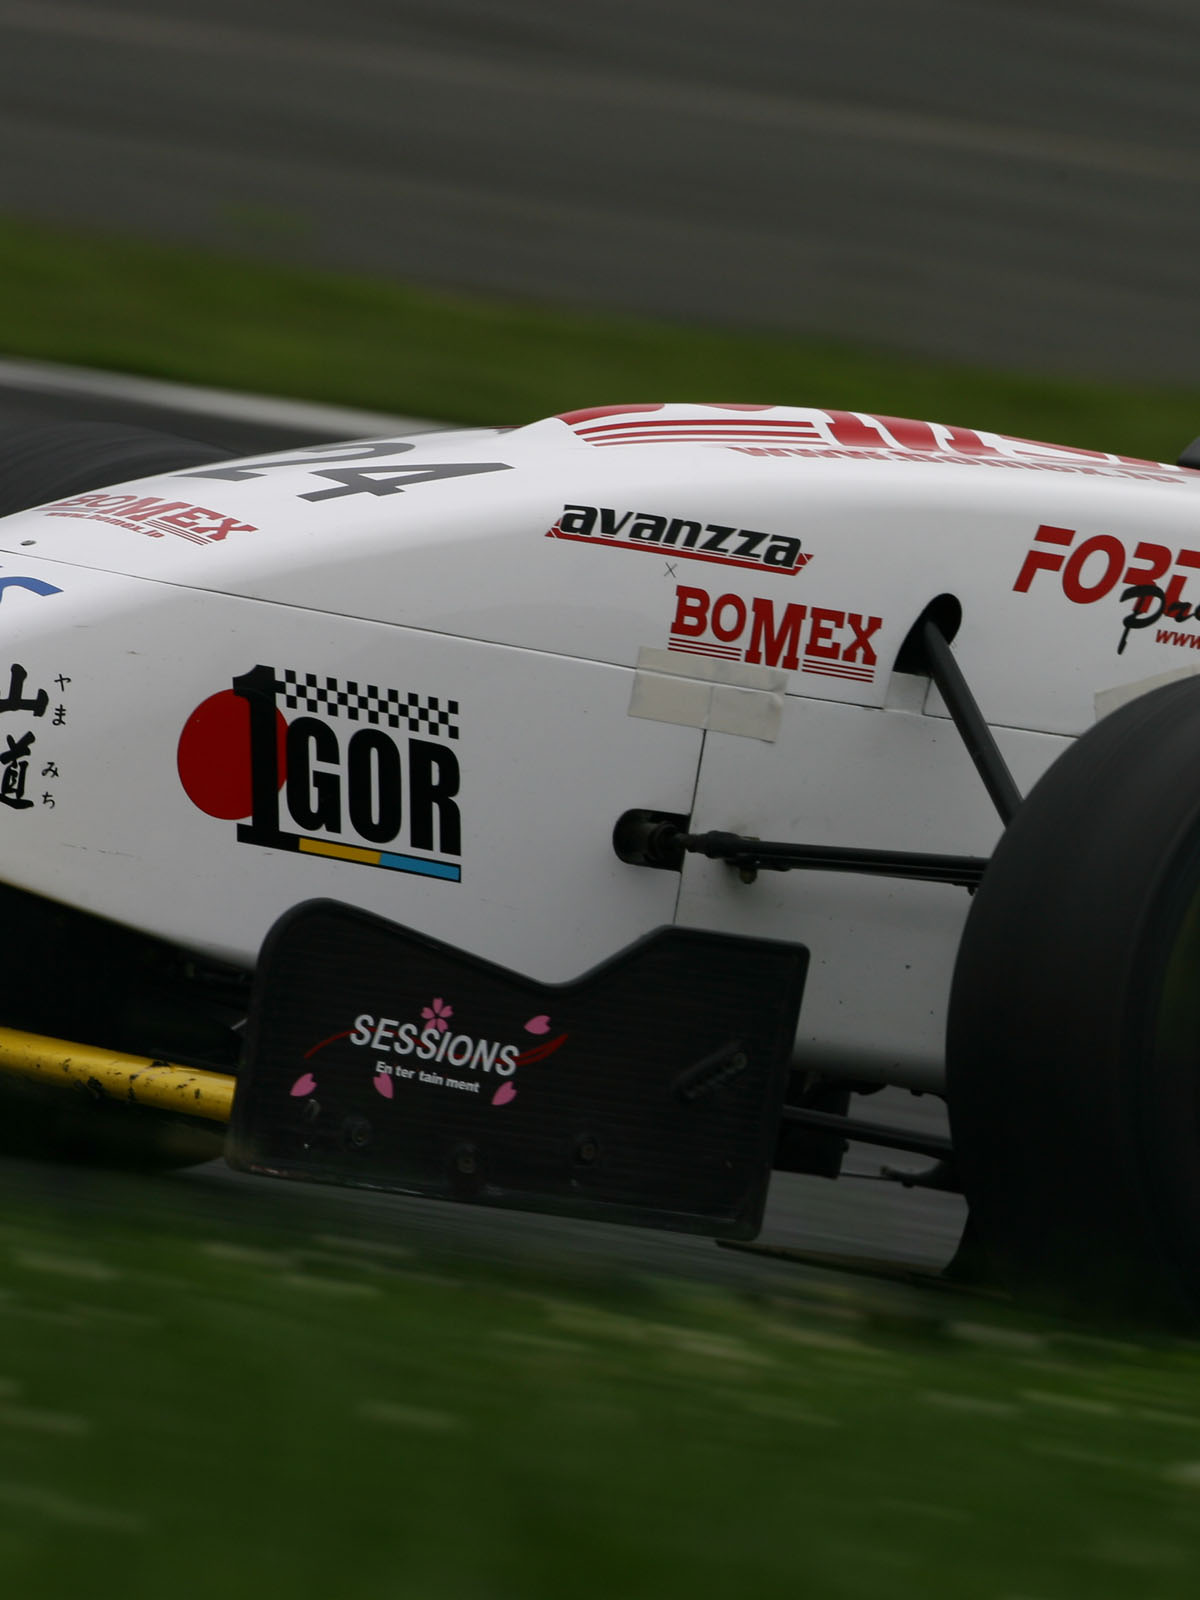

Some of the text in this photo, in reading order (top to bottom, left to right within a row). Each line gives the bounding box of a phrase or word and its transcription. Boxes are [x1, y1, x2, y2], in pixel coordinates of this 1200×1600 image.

[50, 494, 259, 541] BOMEX
[561, 504, 802, 568] avanzza
[670, 585, 882, 669] BOMEX
[350, 1014, 520, 1077] SESSIONS
